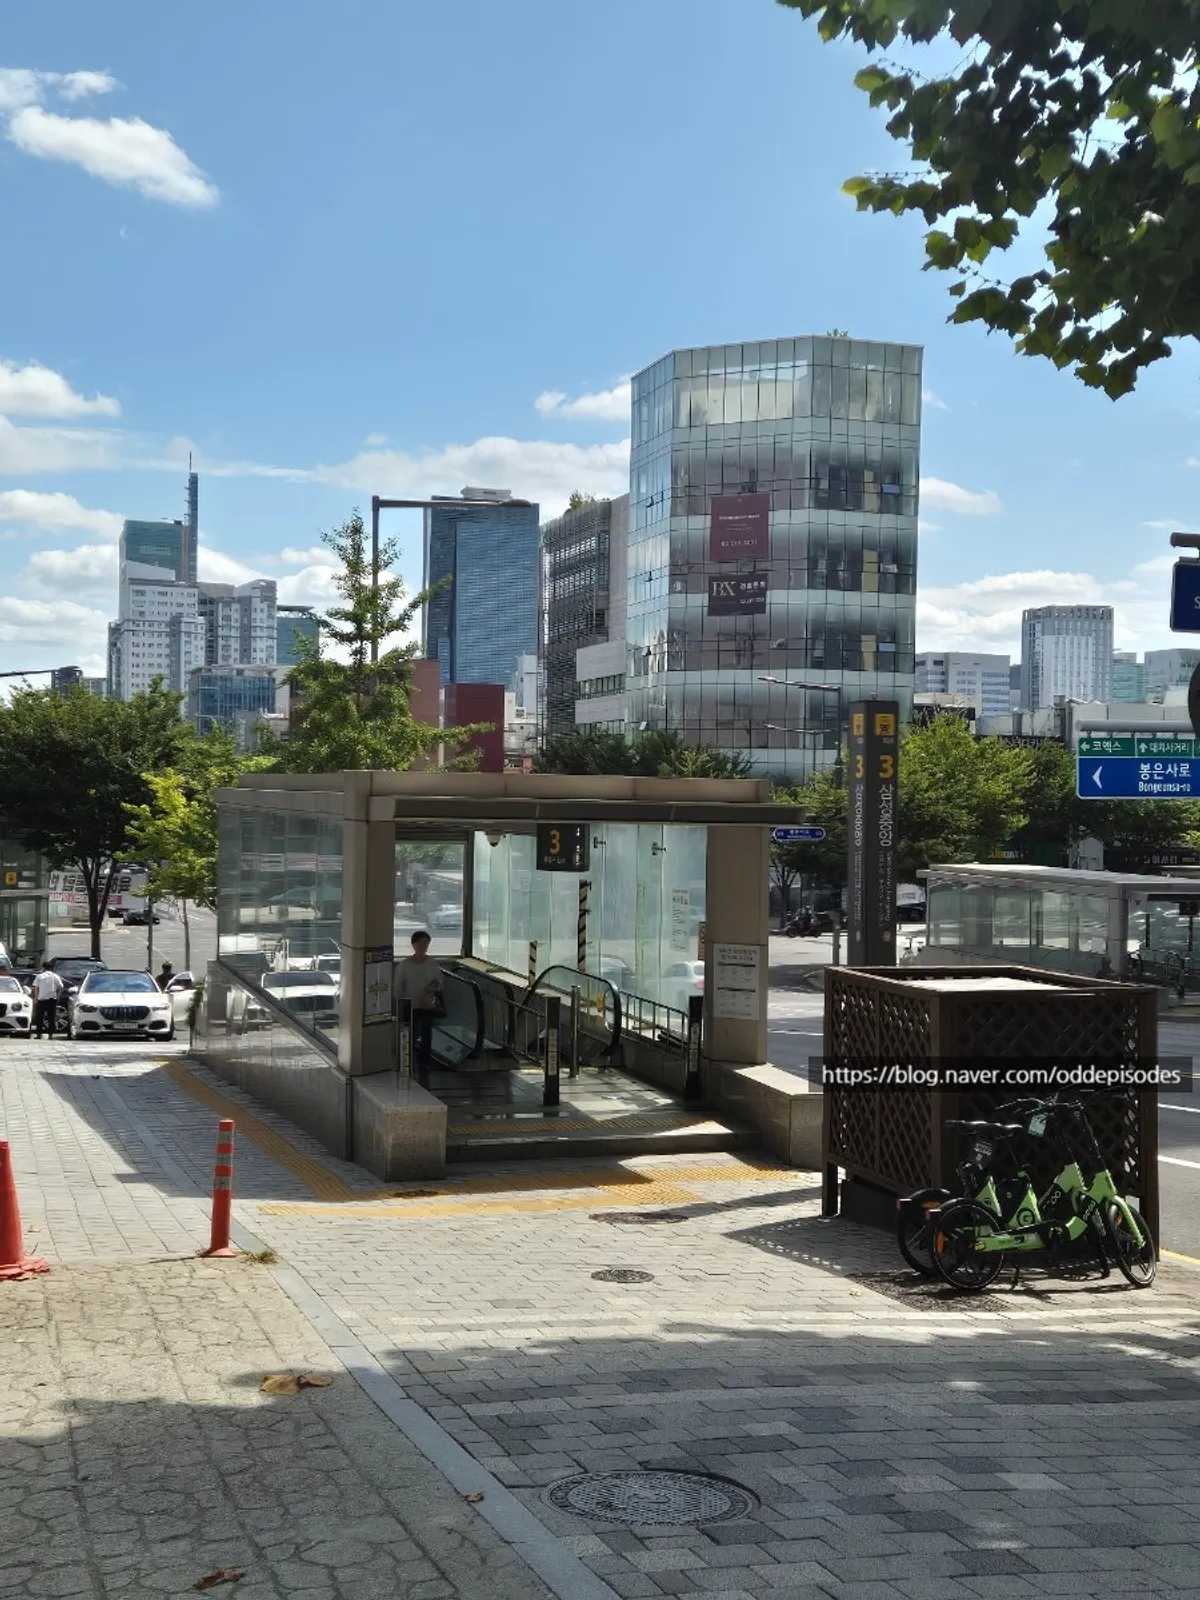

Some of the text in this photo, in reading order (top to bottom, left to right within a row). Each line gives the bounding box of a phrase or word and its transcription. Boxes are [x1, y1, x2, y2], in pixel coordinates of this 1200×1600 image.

[1092, 741, 1122, 753] 코엑스
[1149, 742, 1189, 753] 대치사거리
[855, 754, 864, 778] 3
[879, 754, 894, 779] 3
[1138, 762, 1192, 780] 봉은사로
[1138, 781, 1192, 794] Bongeunsa-ro
[879, 783, 894, 847] 삼성중앙
[550, 829, 561, 855] 3
